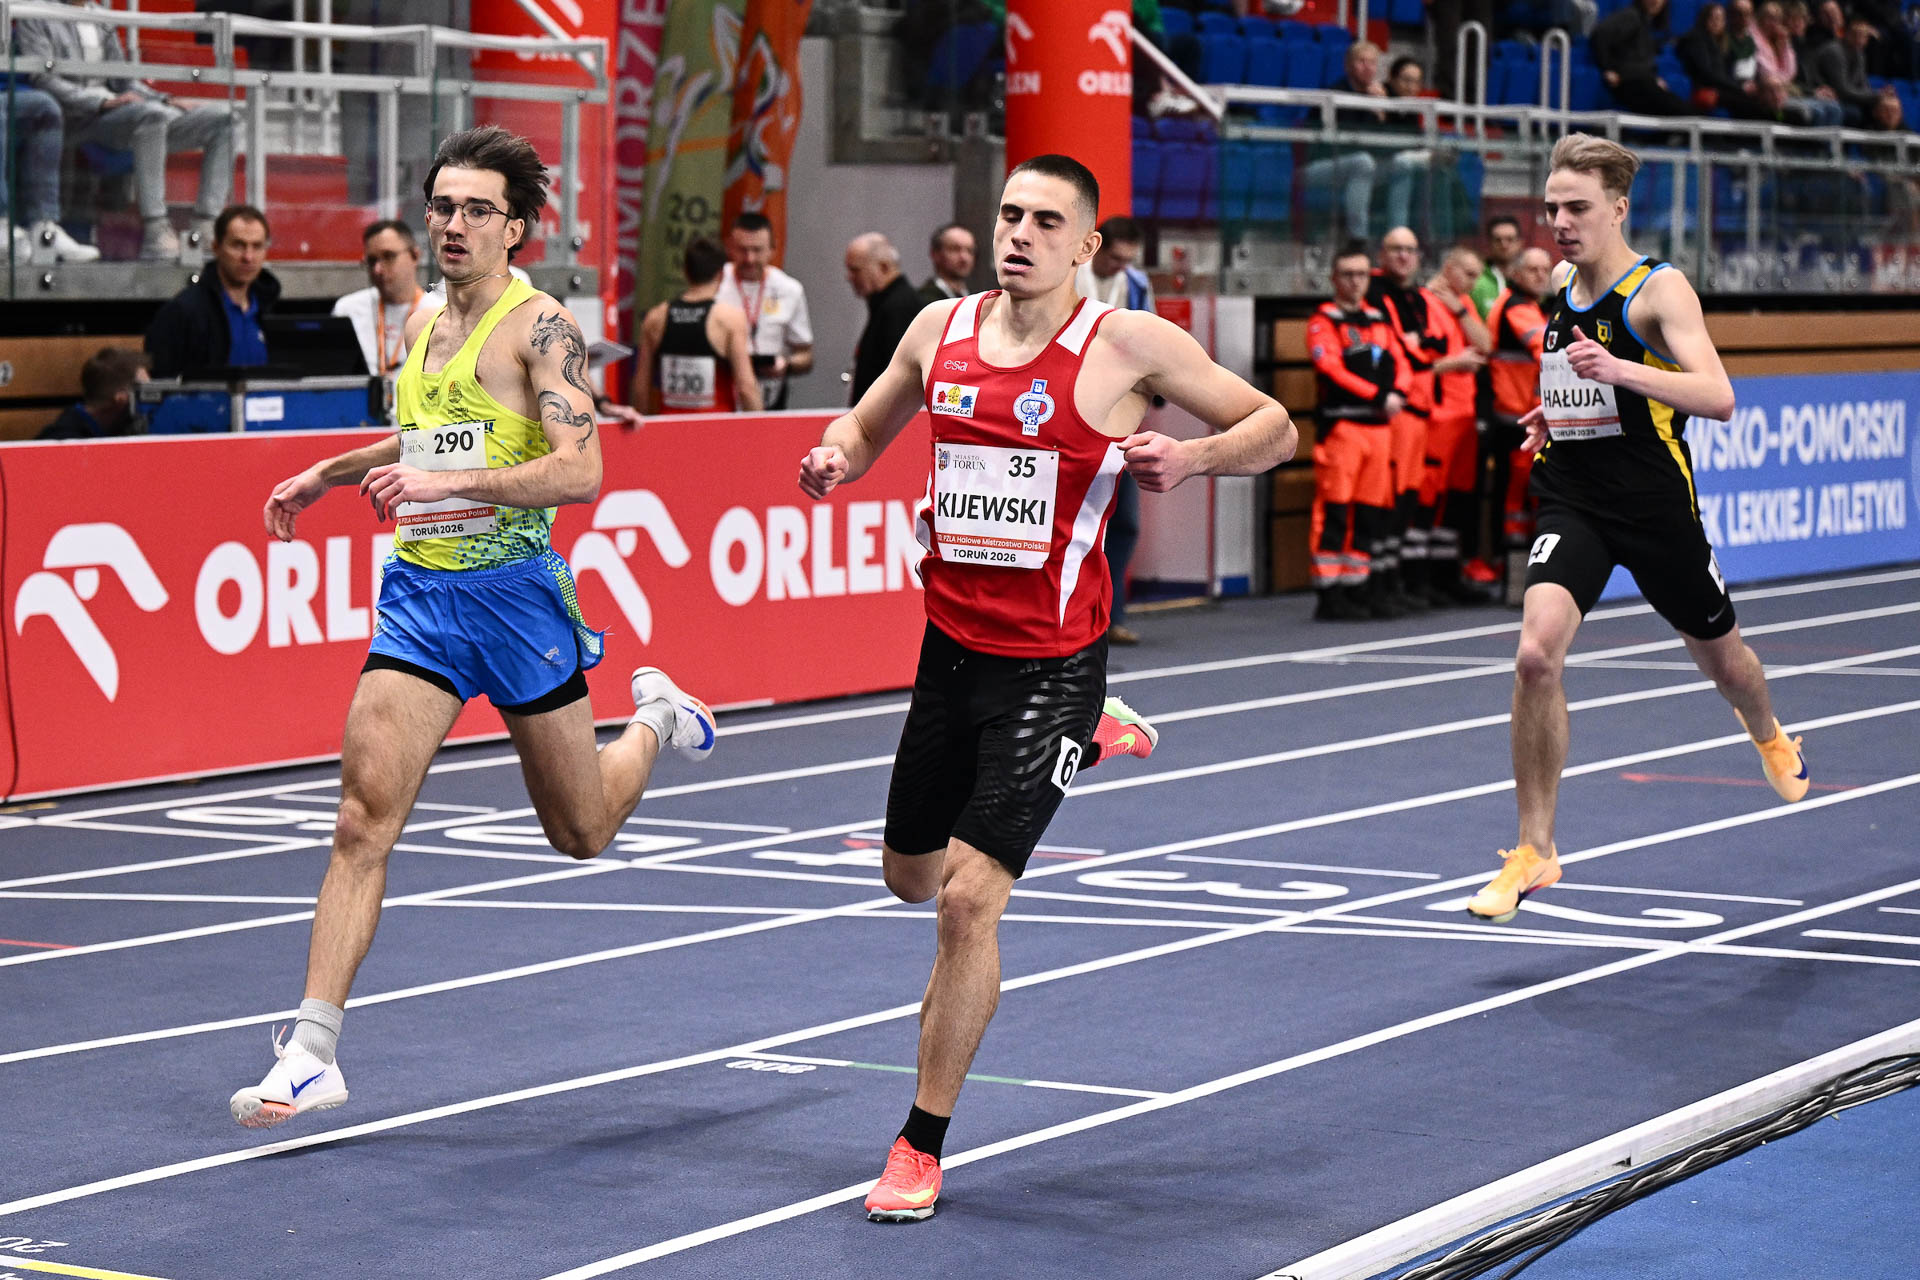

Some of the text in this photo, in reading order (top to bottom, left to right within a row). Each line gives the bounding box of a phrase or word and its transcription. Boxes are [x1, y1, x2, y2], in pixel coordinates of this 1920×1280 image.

[944, 359, 968, 372] esa
[1543, 387, 1606, 408] HAŁUJA
[932, 405, 970, 416] BYDGOSZCZ
[434, 430, 474, 455] 290
[953, 459, 986, 471] TORUŃ
[1008, 455, 1037, 478] 35
[431, 511, 467, 521] Mistrzostwa
[468, 508, 489, 517] Polski
[937, 491, 1047, 526] KIJEWSKI
[1727, 486, 1815, 547] LEKKIEJ
[1816, 478, 1907, 538] ATLETYKI
[410, 523, 464, 537] TORUŃ 2026
[943, 534, 956, 542] PZLA
[956, 535, 981, 545] Halowe
[982, 537, 1022, 548] Mistrzostwa
[1023, 542, 1045, 550] Polski
[953, 548, 1017, 563] TORUŃ 2026
[1060, 746, 1079, 786] 6
